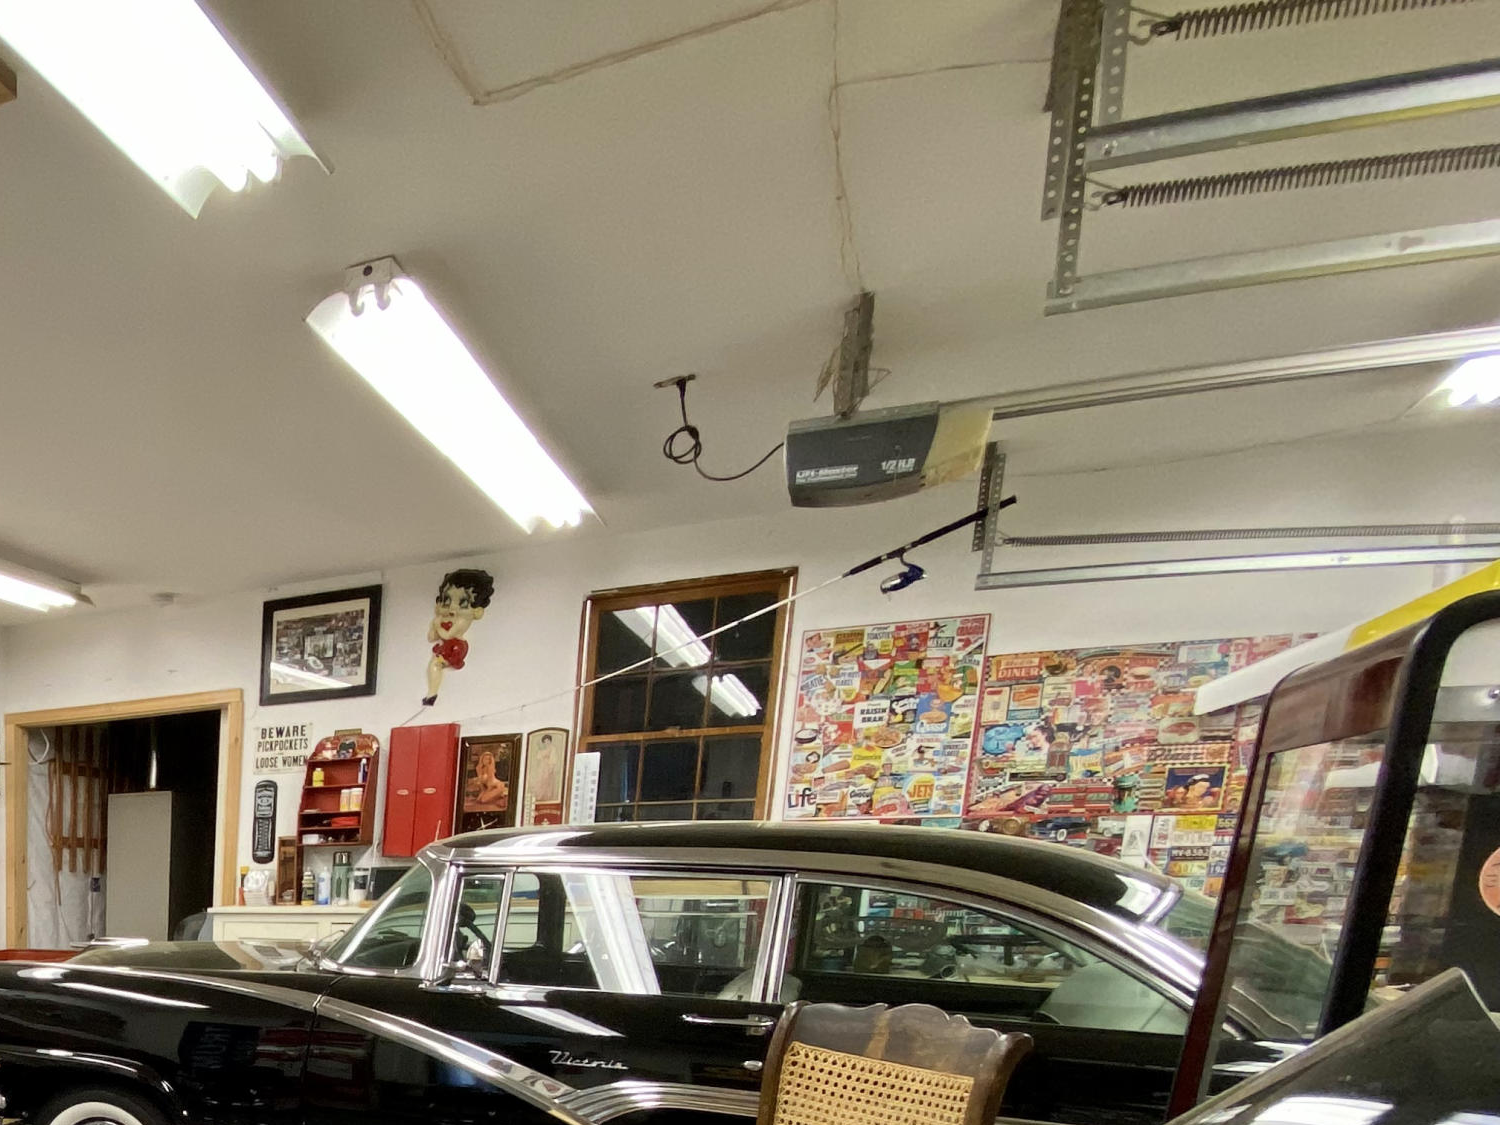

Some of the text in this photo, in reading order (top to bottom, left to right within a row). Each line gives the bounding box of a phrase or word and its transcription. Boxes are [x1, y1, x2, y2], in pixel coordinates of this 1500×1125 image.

[261, 725, 307, 740] BEWARE
[257, 738, 309, 753] PICKPOCKETS
[255, 757, 279, 769] LOOSE
[788, 787, 818, 809] Life
[909, 783, 934, 799] JETS
[549, 1050, 629, 1070] Victoria
